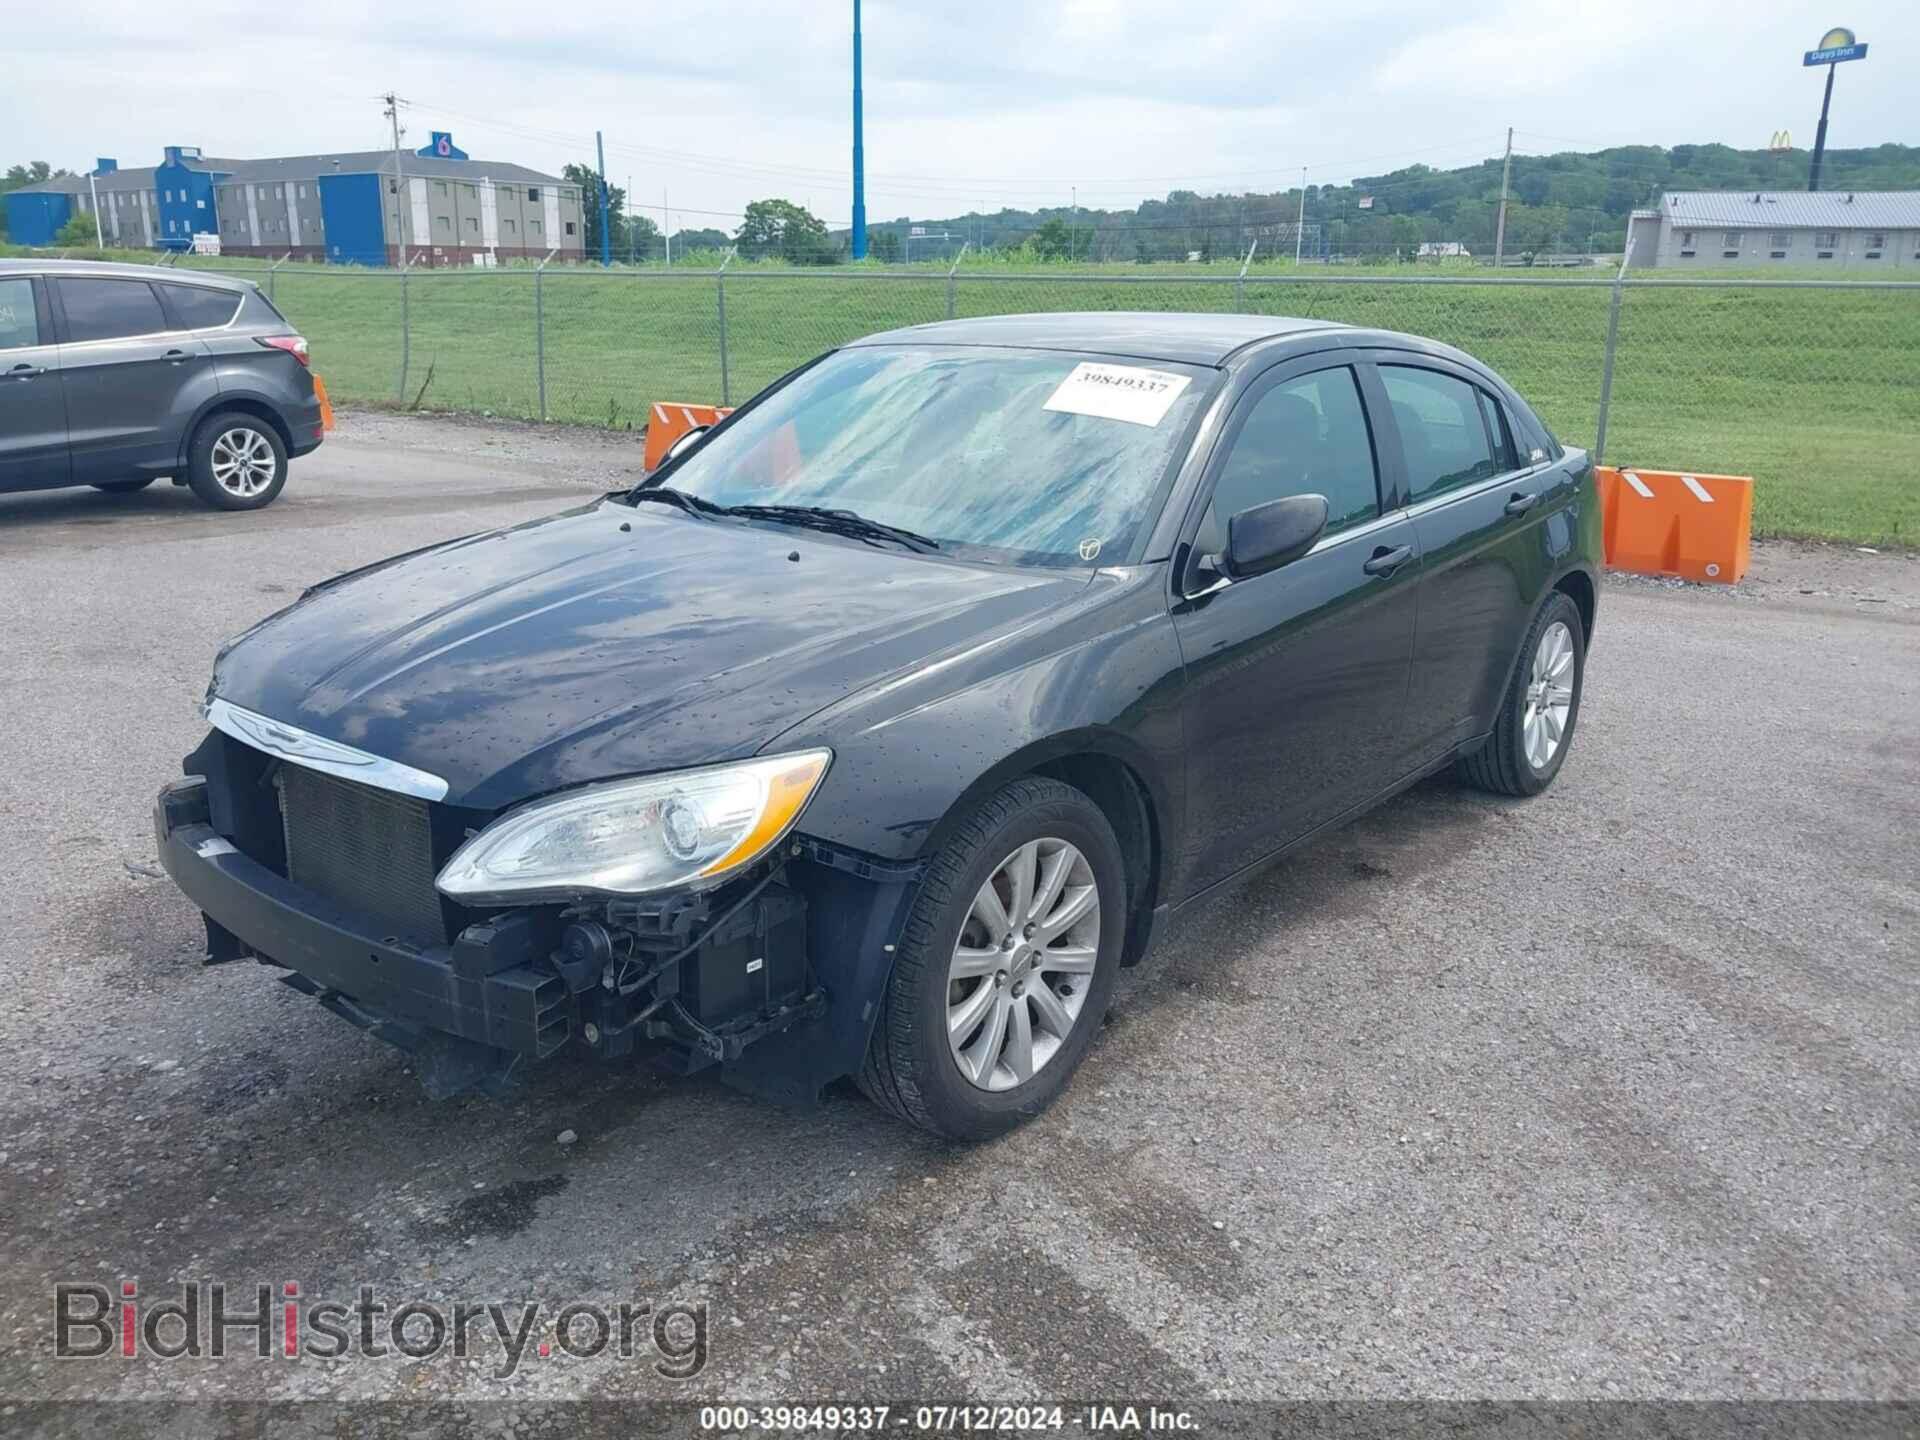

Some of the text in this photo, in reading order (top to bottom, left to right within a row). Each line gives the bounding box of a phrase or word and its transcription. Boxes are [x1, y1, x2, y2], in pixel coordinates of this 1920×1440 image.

[1811, 48, 1855, 61] Days Inn
[438, 135, 450, 156] 6
[1077, 371, 1169, 393] 39849337
